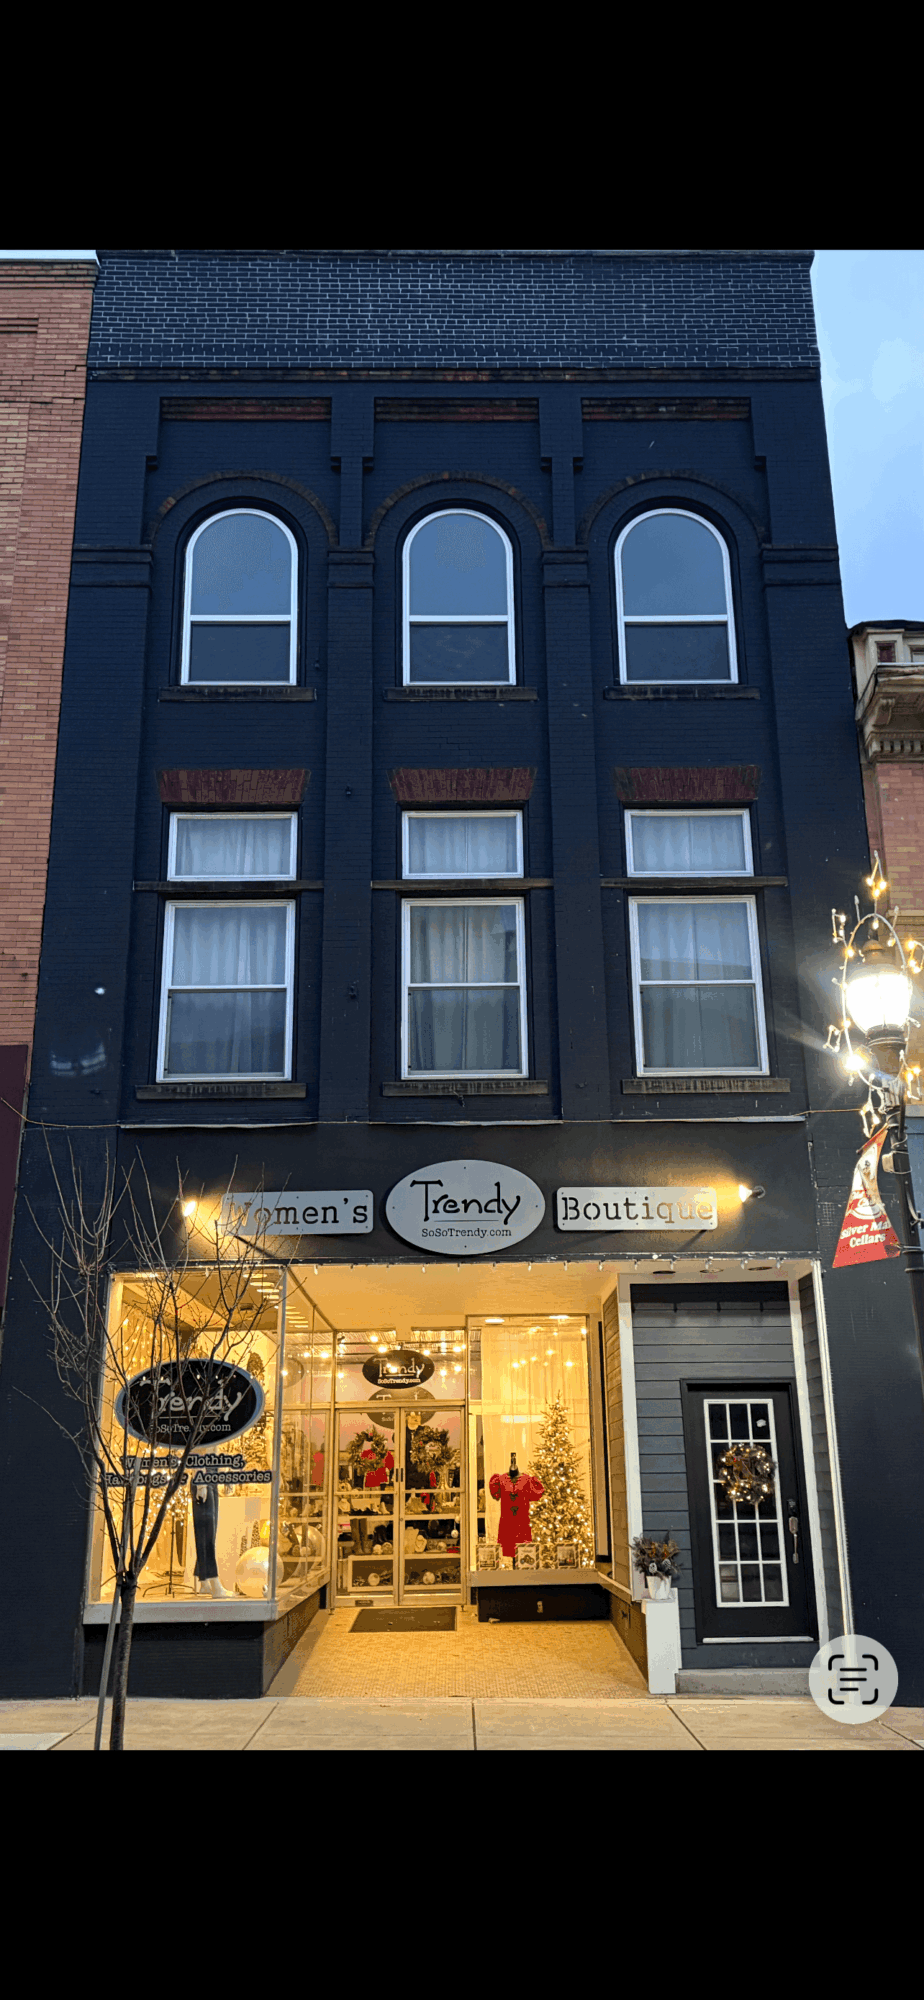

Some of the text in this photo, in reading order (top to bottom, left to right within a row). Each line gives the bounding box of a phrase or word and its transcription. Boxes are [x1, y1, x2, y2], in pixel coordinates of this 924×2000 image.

[409, 1179, 521, 1226] Trendy
[561, 1196, 714, 1224] Boutique
[229, 1197, 368, 1227] Women's
[421, 1228, 512, 1239] SoSoTrendy.com
[849, 1233, 887, 1248] Cellars
[373, 1357, 425, 1379] Trndy
[150, 1423, 232, 1433] oSoTrey.com
[120, 1455, 245, 1468] Wmen's Clothing,
[194, 1471, 272, 1484] Accessories
